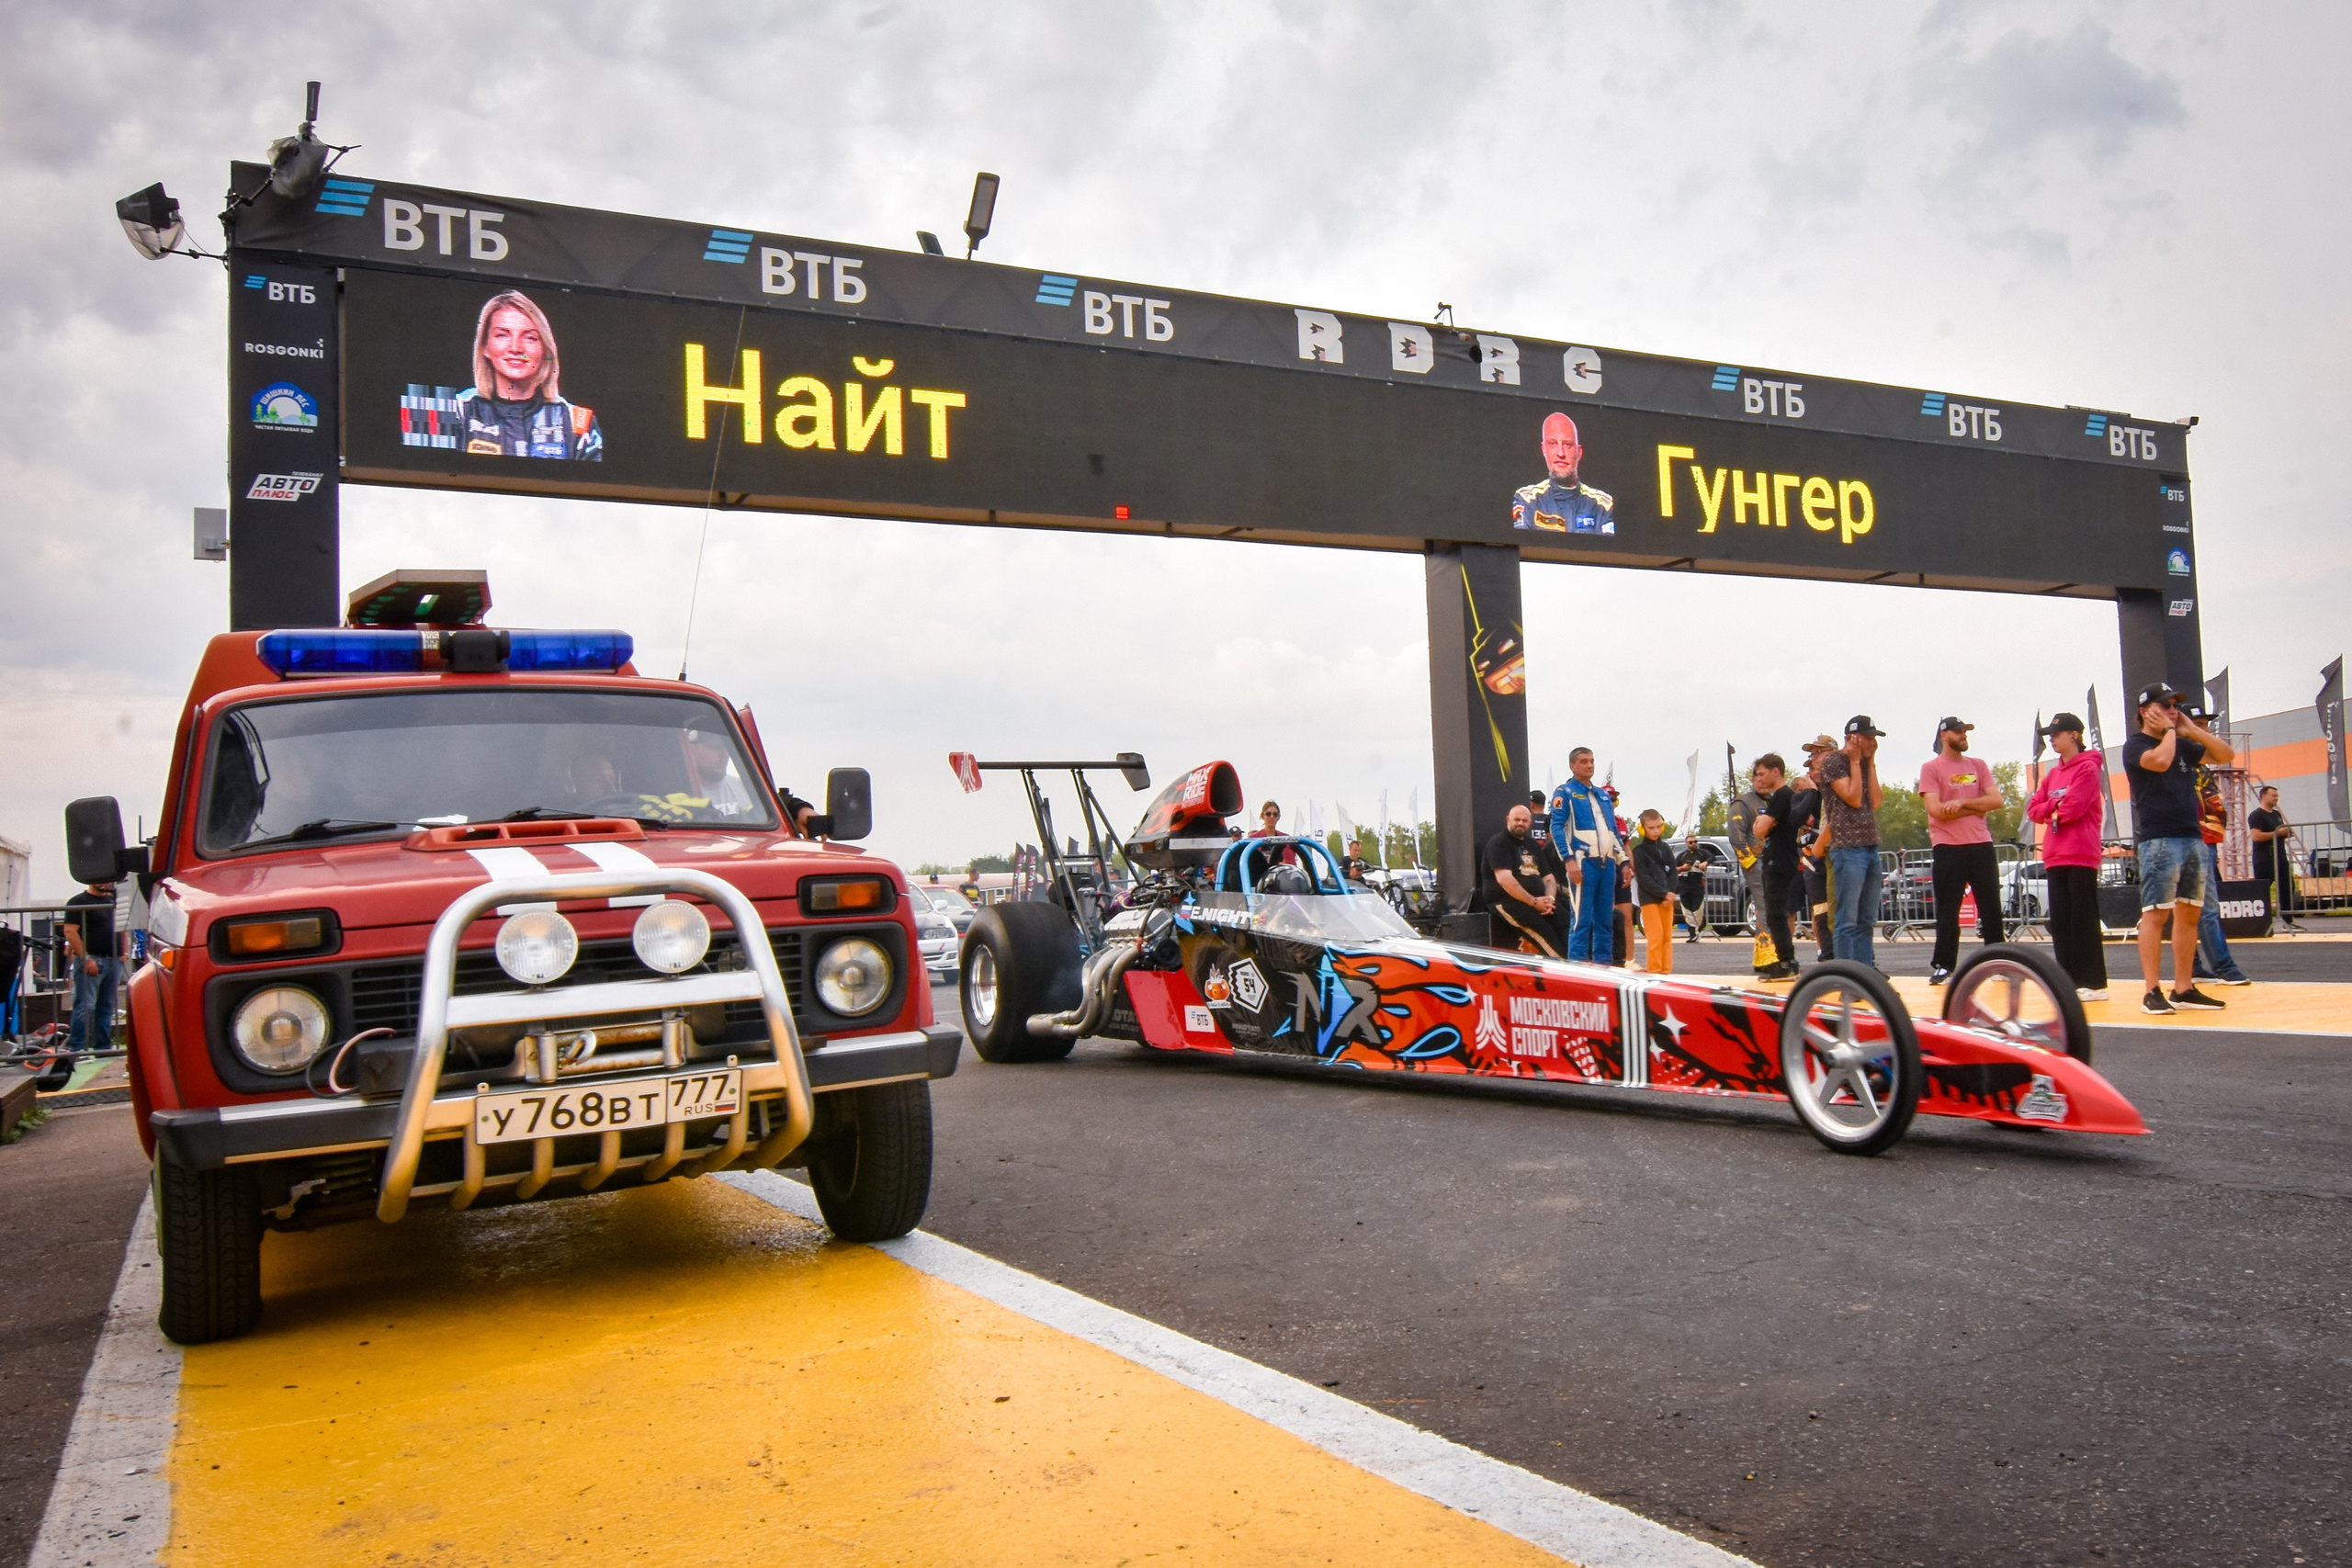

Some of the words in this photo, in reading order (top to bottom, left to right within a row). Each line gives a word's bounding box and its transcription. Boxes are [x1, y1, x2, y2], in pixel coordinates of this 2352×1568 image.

[383, 198, 509, 261] ВТБ
[760, 247, 867, 304] ВТБ
[268, 281, 316, 304] ВТБ
[1083, 291, 1174, 342] ВТБ
[244, 338, 323, 359] ROSGONKI
[684, 344, 967, 459] Найт
[1744, 378, 1805, 418] ВТБ
[1948, 403, 2002, 442] ВТБ
[2109, 425, 2157, 461] ВТБ
[252, 490, 294, 499] ПЛЮС
[256, 477, 315, 491] АВТО
[1657, 445, 1873, 543] Гунгер
[2167, 490, 2185, 502] ВТБ
[2172, 602, 2191, 610] АВТО
[1182, 781, 1207, 801] RIDE
[1190, 905, 1253, 924] E.NIGHT
[2219, 900, 2265, 919] RDRC
[1243, 977, 1257, 994] 54
[1197, 1014, 1209, 1026] ВТБ
[1510, 997, 1610, 1032] МОСКОВСКИЙ
[1511, 1027, 1558, 1058] СПОРТ
[671, 1075, 729, 1107] 777
[684, 1104, 714, 1116] RUS
